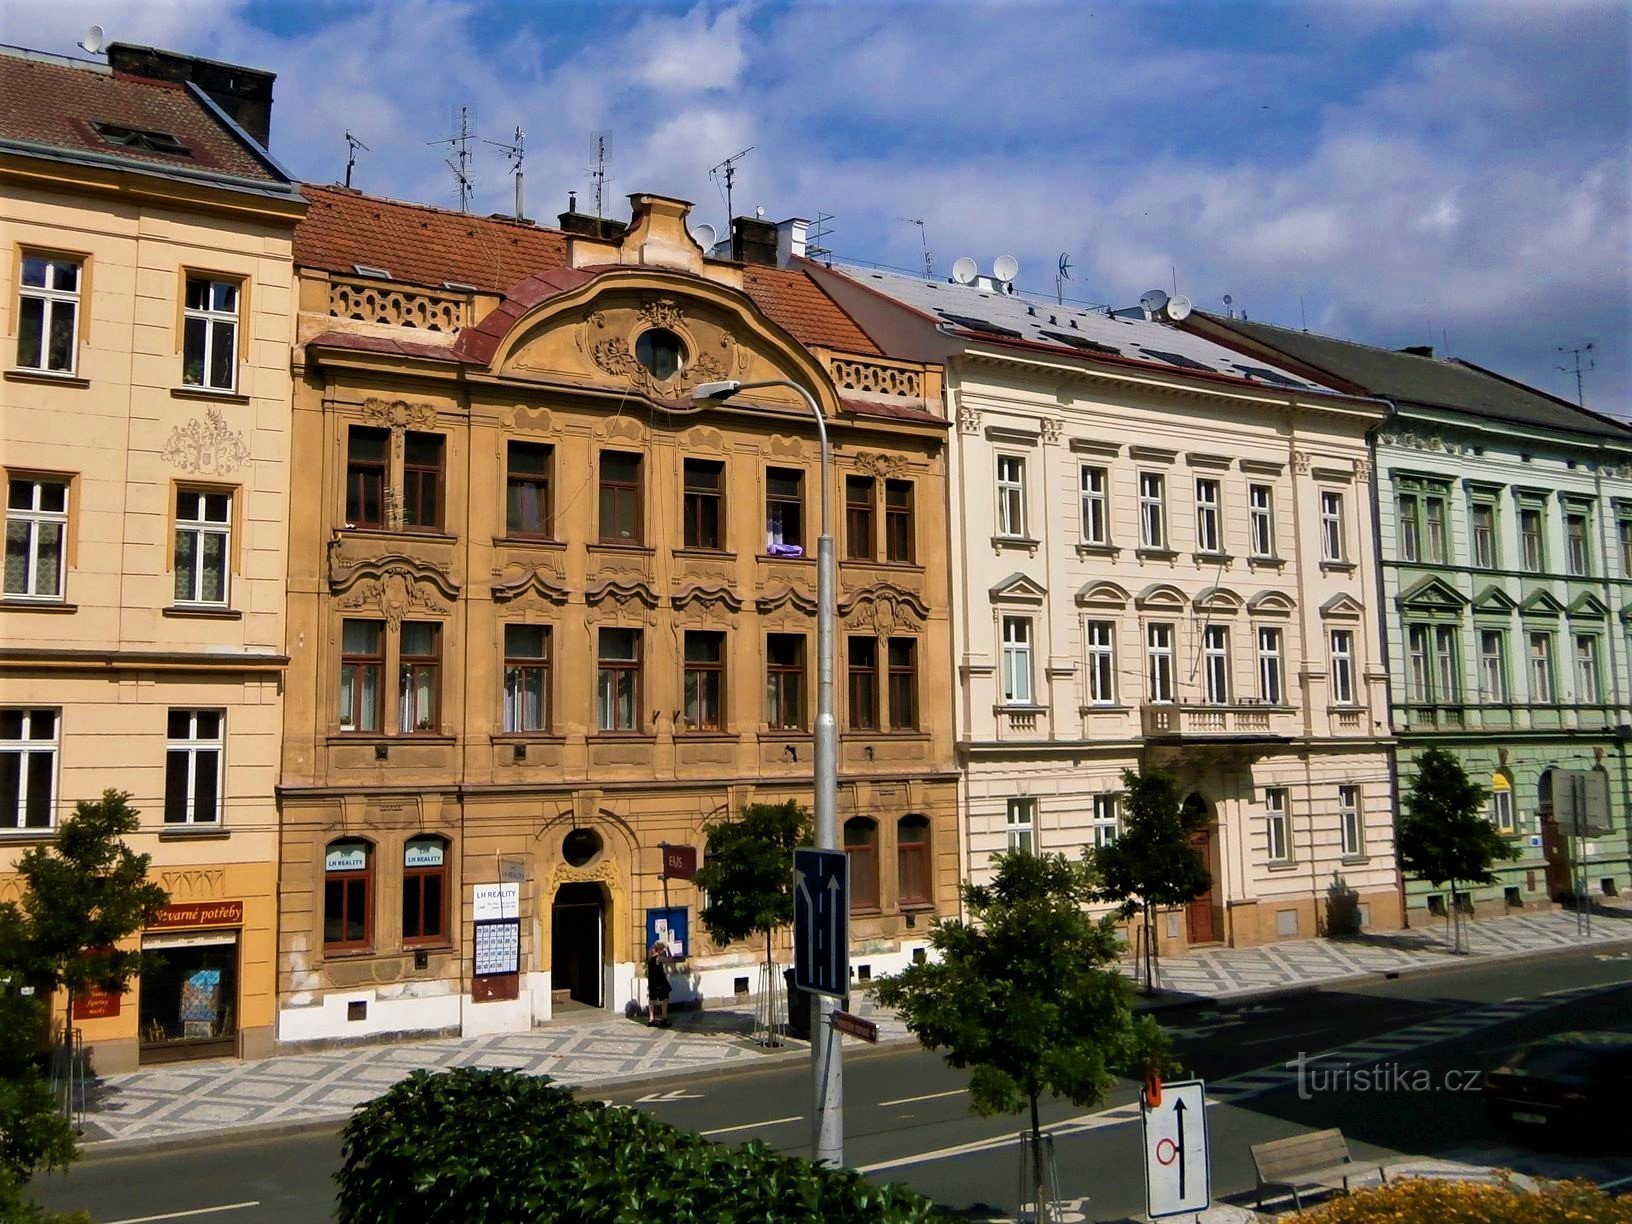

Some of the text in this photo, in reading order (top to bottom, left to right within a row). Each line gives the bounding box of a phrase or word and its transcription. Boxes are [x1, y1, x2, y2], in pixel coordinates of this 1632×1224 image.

[476, 890, 516, 899] LH REALITY
[200, 904, 242, 924] potřeby
